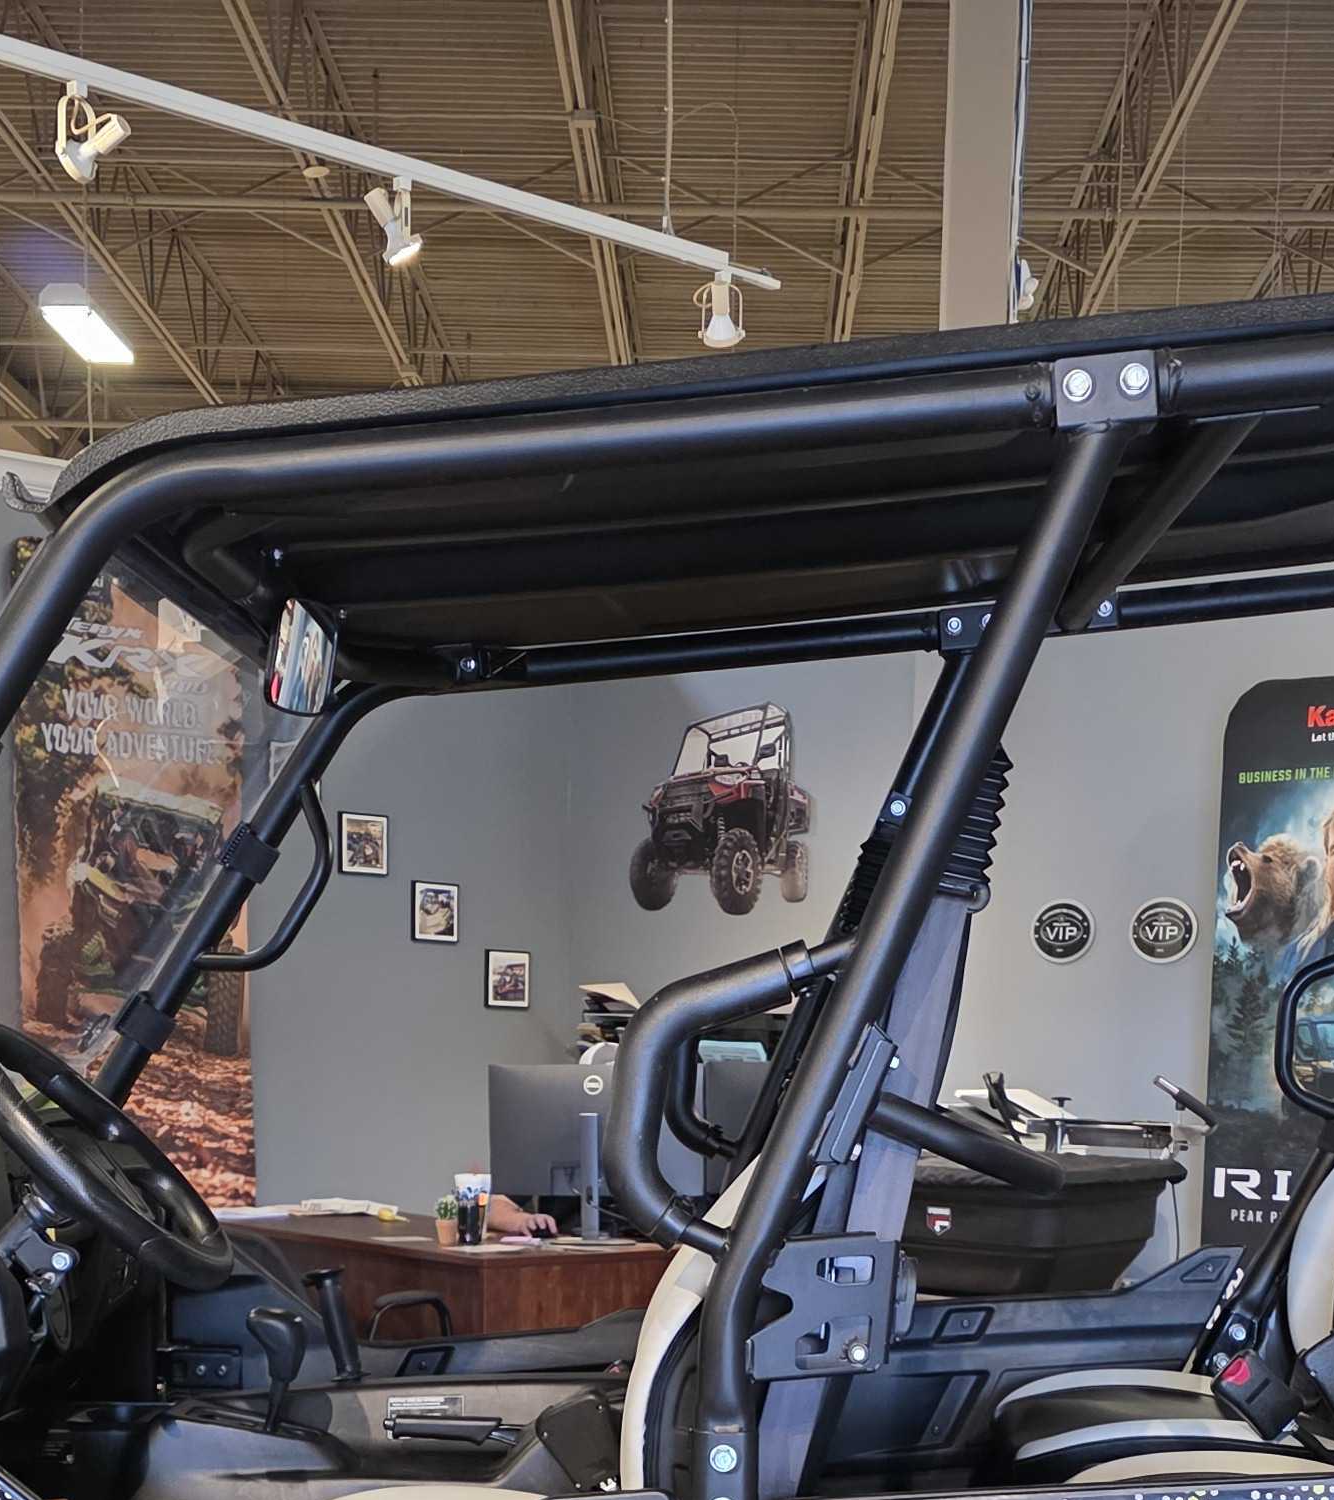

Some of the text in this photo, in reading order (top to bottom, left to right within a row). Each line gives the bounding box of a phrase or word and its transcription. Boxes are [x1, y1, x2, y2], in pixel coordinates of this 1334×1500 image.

[61, 687, 118, 722] YOUR
[40, 722, 99, 757] YOUR
[1311, 732, 1327, 742] Let
[1238, 768, 1292, 785] BUSINESS
[1294, 767, 1307, 780] IN
[1310, 766, 1331, 780] THE
[1045, 926, 1078, 941] VIP
[1144, 925, 1179, 941] VIP
[1213, 1167, 1293, 1201] RI
[1230, 1208, 1263, 1223] PEAK
